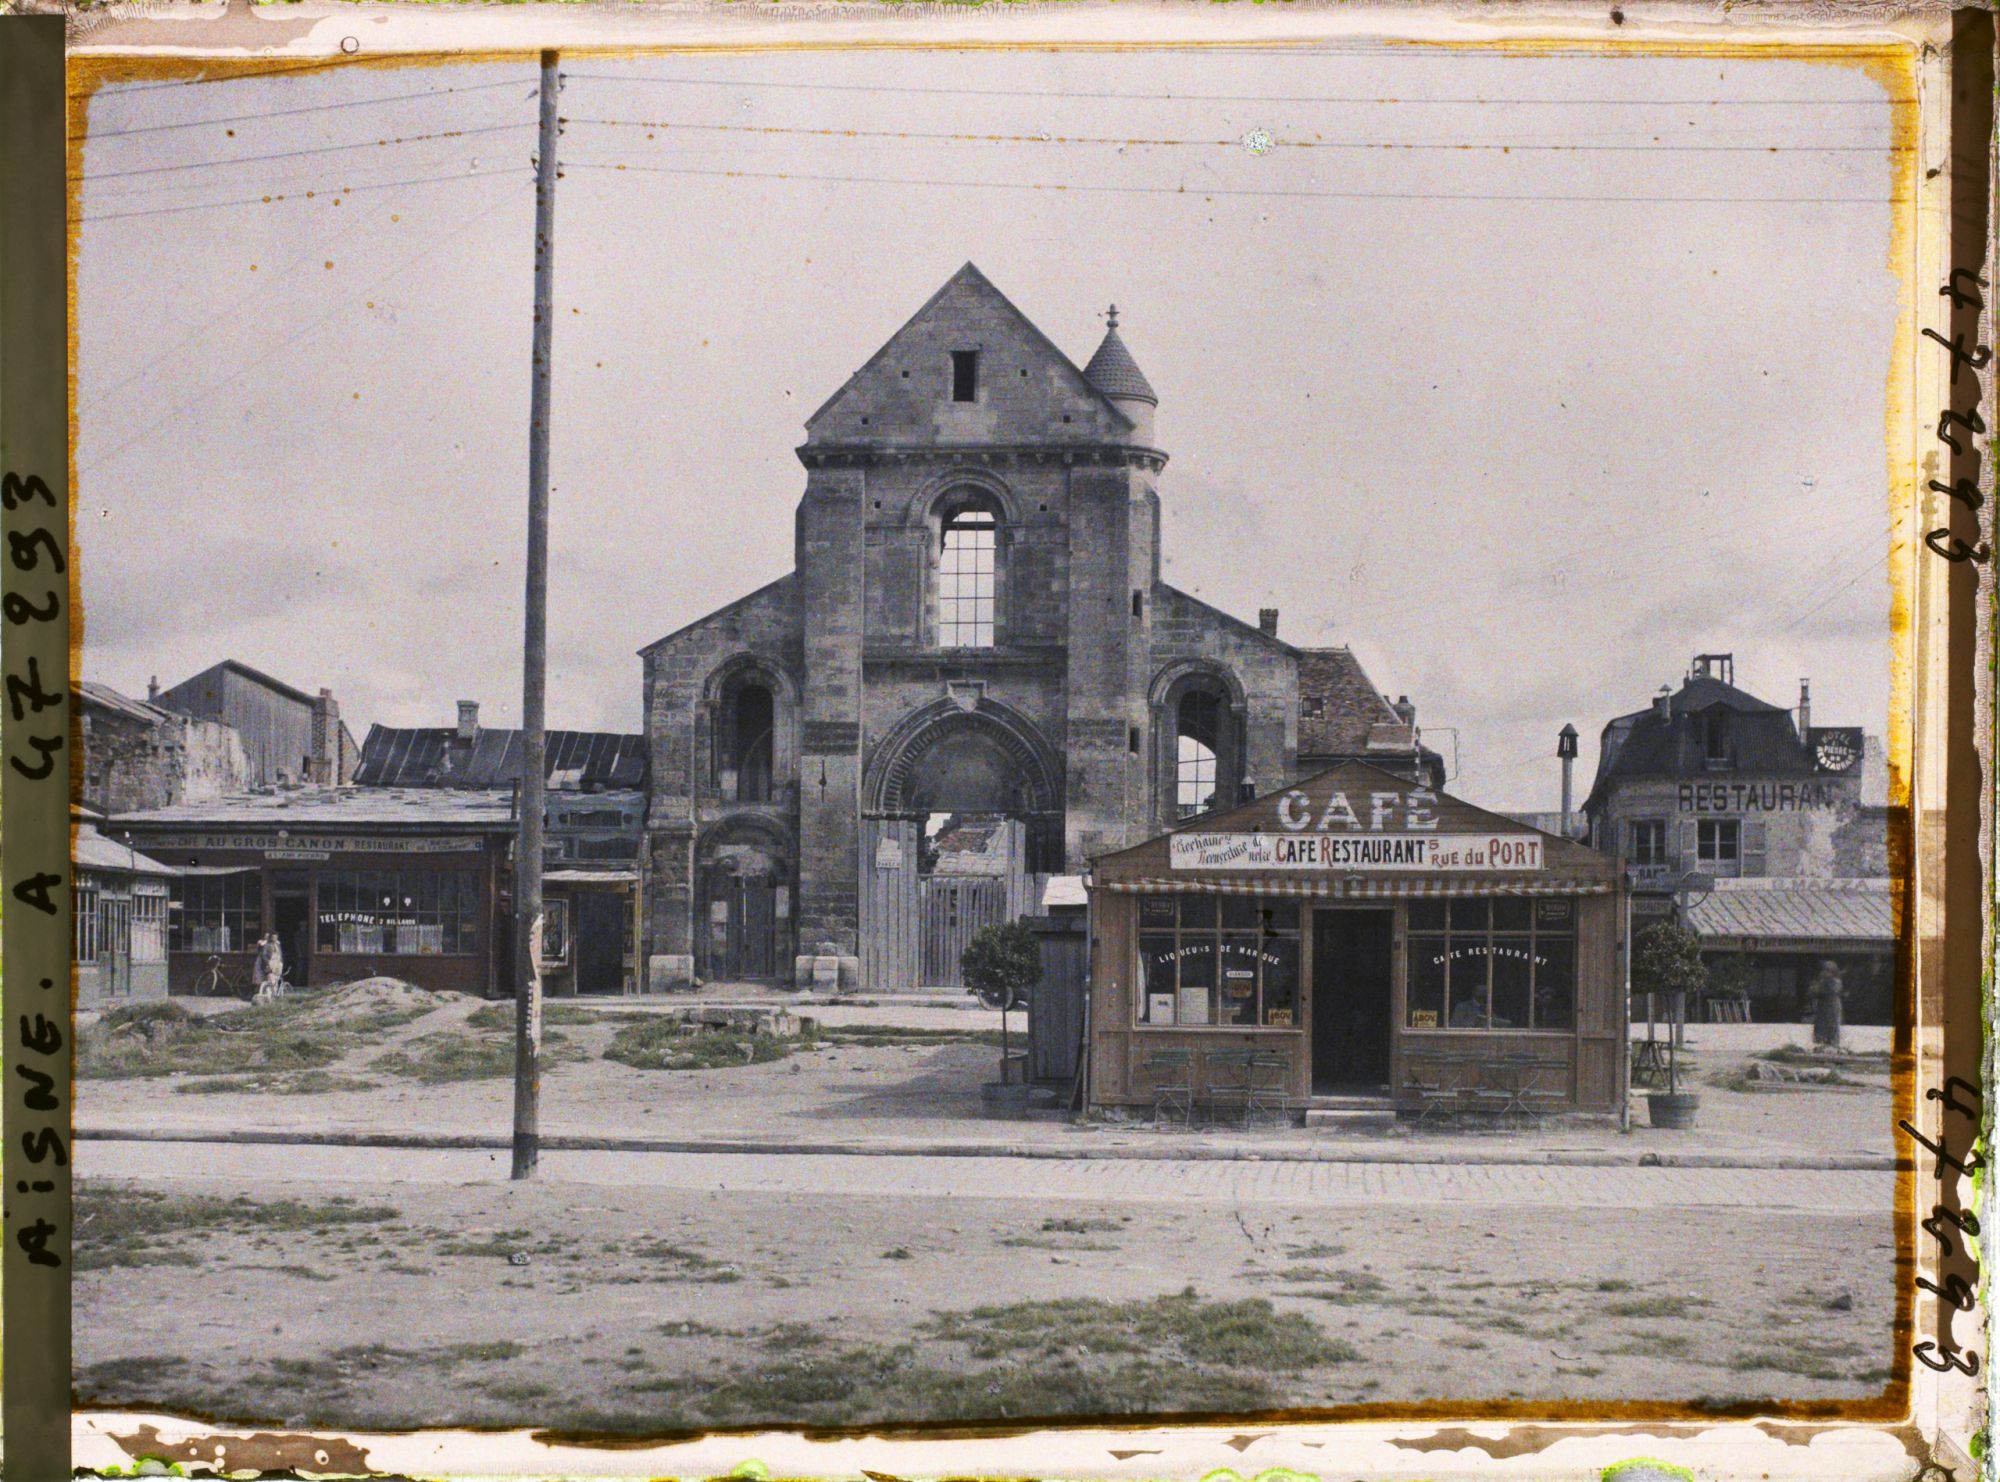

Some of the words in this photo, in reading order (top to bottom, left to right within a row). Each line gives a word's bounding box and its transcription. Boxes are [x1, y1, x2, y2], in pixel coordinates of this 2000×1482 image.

[1277, 786, 1440, 831] CAFÉ
[205, 837, 225, 847] AU
[233, 837, 278, 848] GROS
[285, 838, 345, 850] CANON
[1320, 837, 1425, 867] RESTAURANT
[1431, 852, 1460, 868] RUE
[1489, 838, 1539, 868] PORT
[1220, 945, 1231, 953] DE
[1433, 951, 1462, 965] CAFE
[1468, 947, 1548, 967] RESTAURANT
